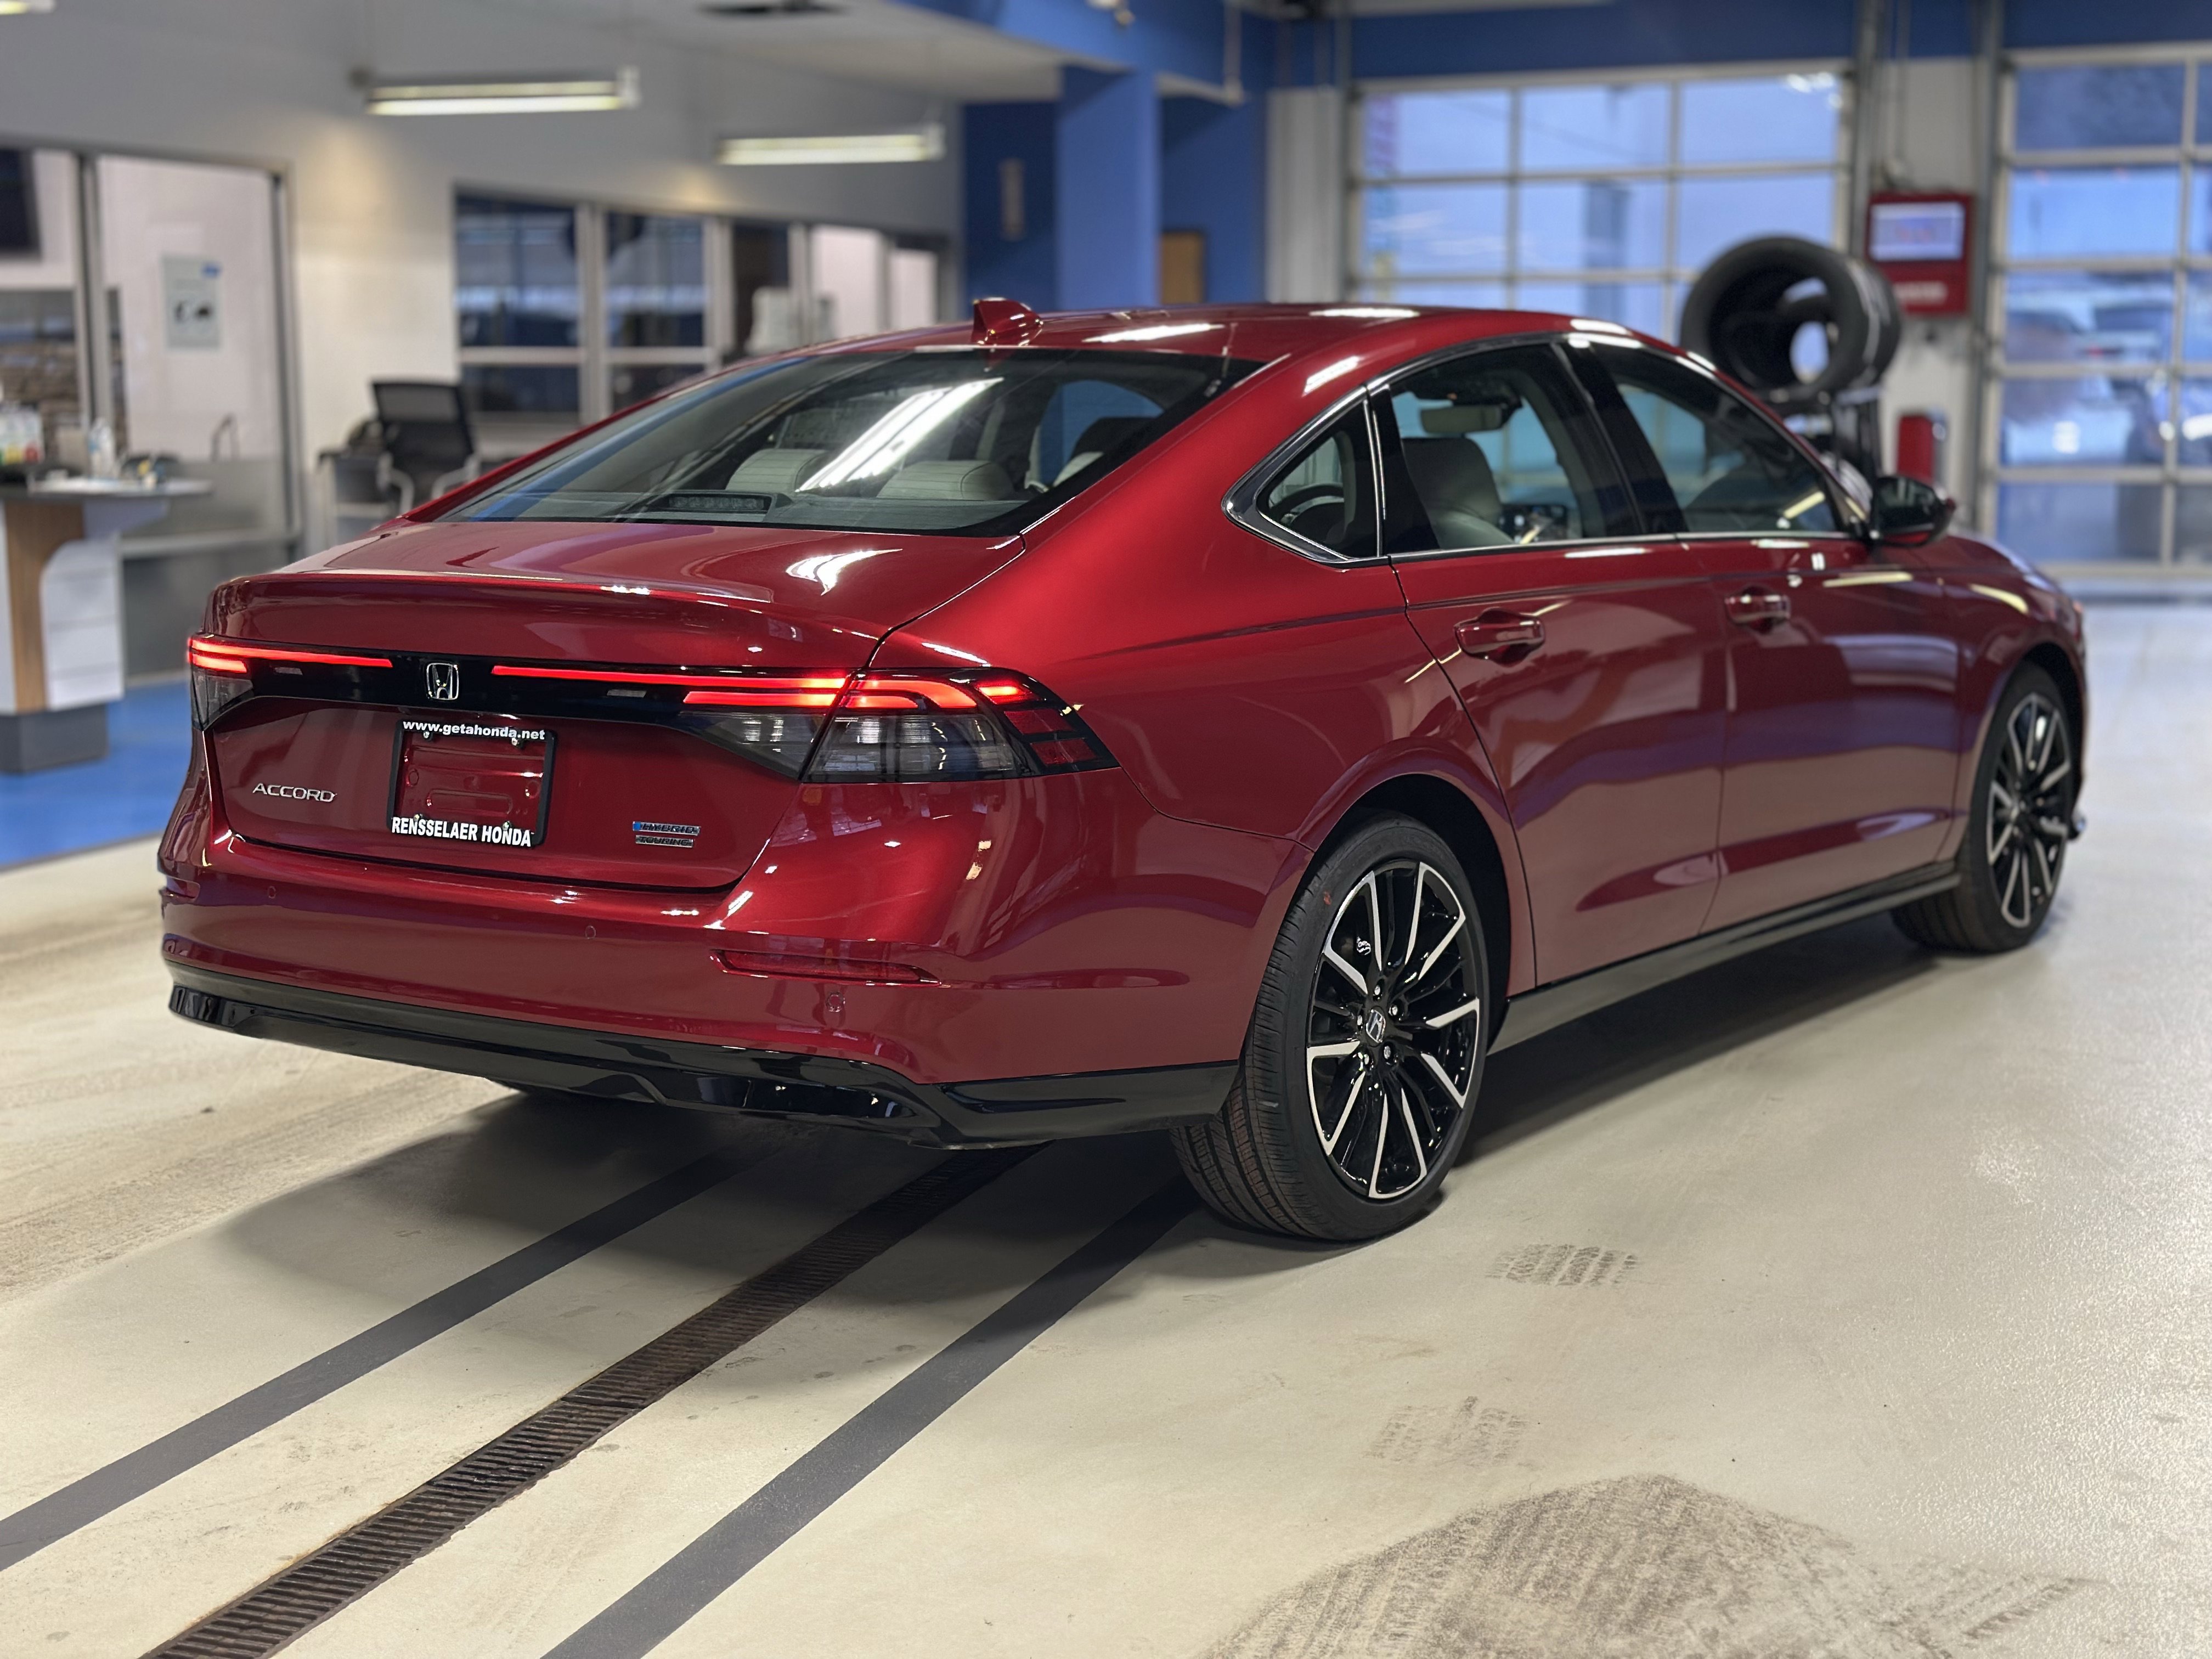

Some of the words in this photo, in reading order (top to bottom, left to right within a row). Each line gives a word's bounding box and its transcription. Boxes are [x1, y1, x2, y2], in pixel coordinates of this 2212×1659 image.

[403, 721, 545, 740] www.getahonda.net
[252, 783, 337, 803] ACCORD
[392, 817, 477, 841] RENSSELAER
[481, 825, 531, 847] HONDA
[638, 836, 690, 845] TOURING
